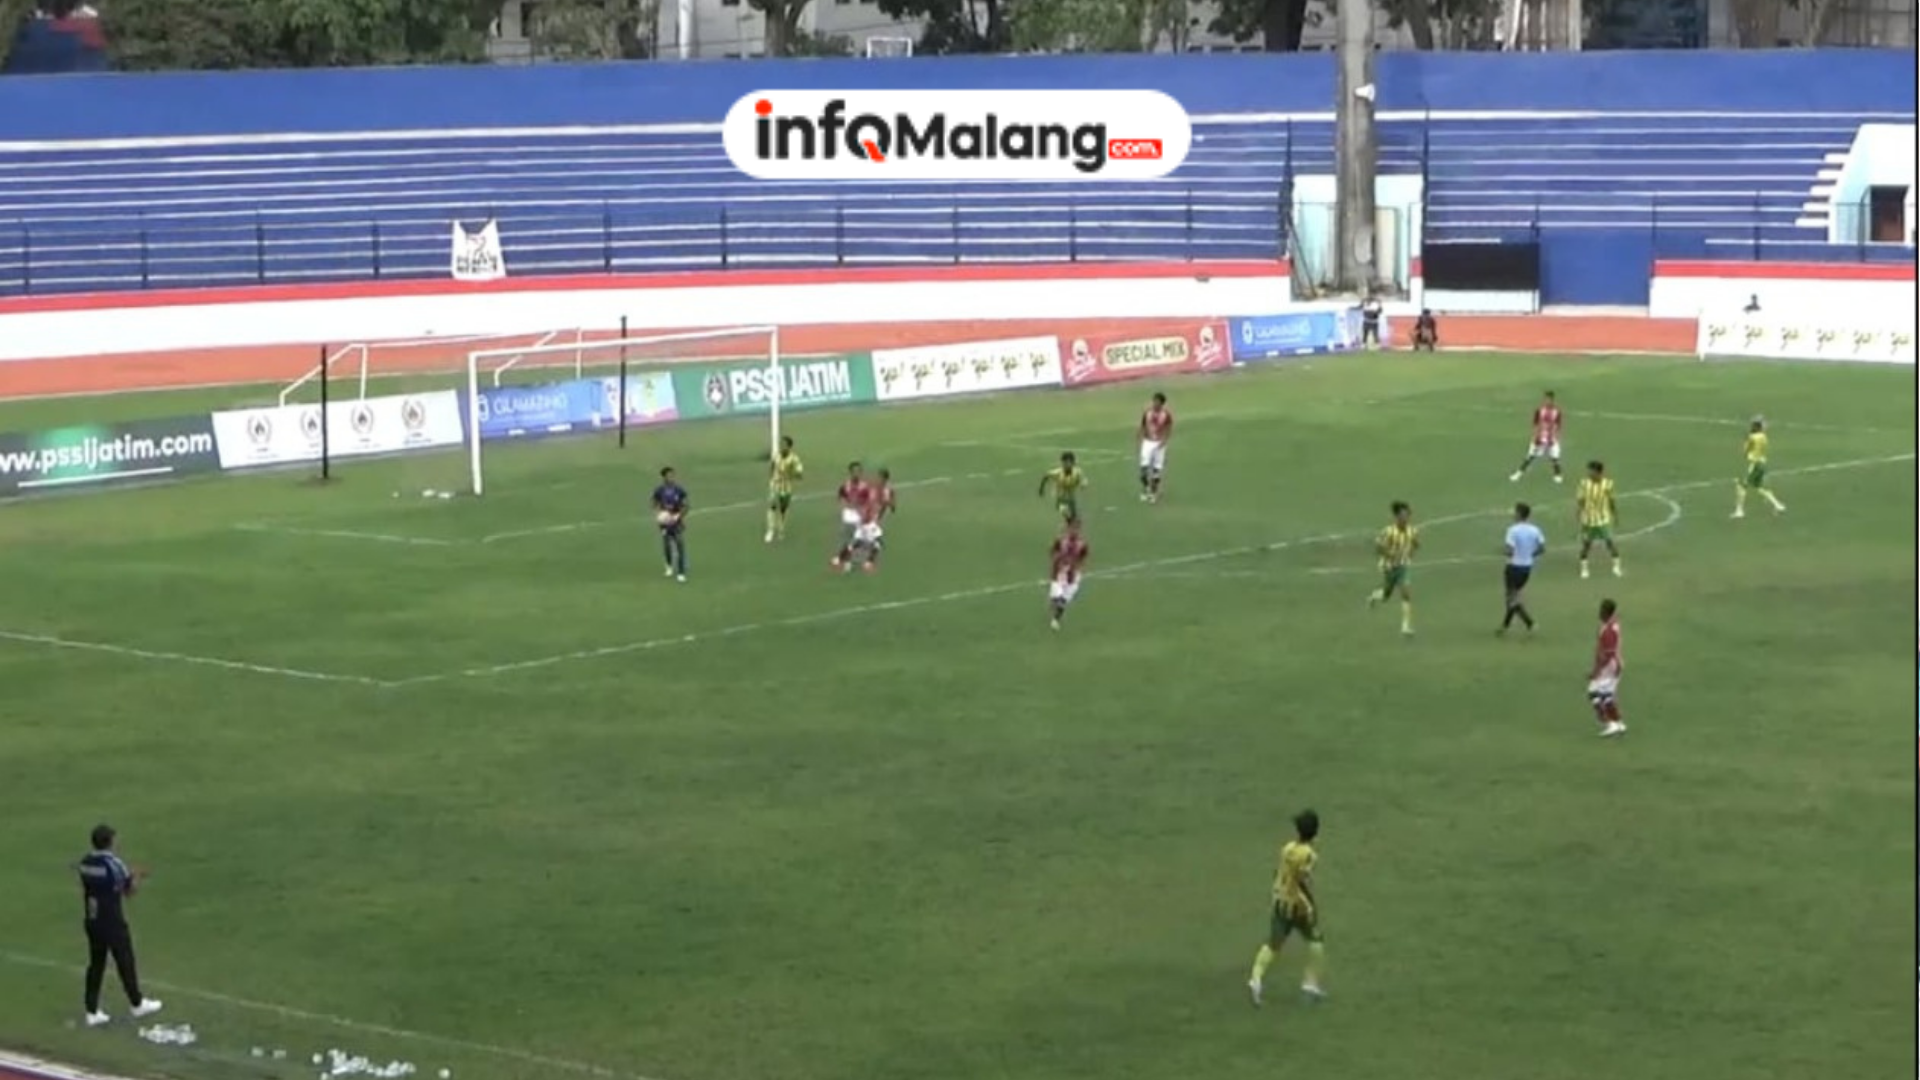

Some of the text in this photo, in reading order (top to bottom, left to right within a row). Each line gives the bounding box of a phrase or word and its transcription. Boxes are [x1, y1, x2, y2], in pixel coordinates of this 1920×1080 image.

[1106, 344, 1160, 366] SPECIAL
[1163, 341, 1186, 359] MIX
[730, 364, 786, 404] PSSI
[789, 360, 850, 399] JATIM
